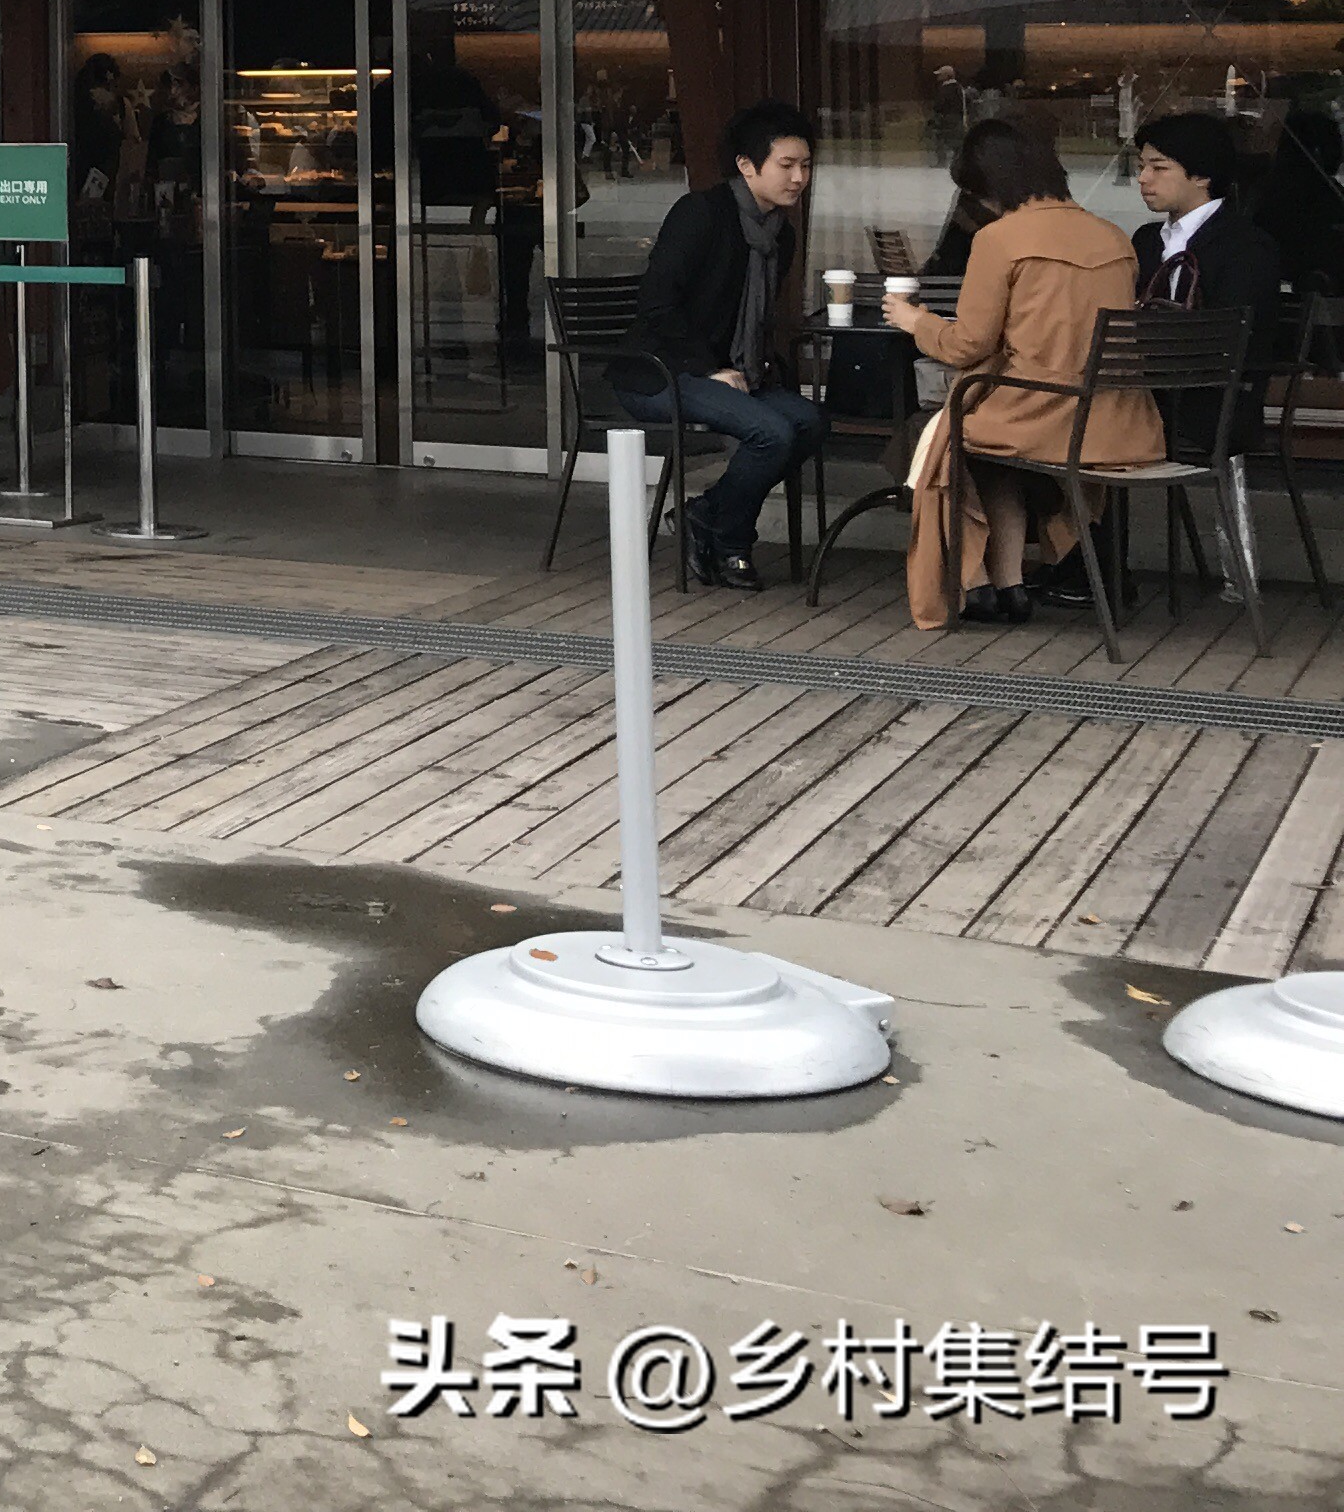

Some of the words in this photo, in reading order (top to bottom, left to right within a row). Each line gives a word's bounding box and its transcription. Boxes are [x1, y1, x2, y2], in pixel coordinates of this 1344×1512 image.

[0, 179, 48, 194] 出口専用
[0, 195, 20, 204] EXIT
[21, 195, 47, 205] ONLY
